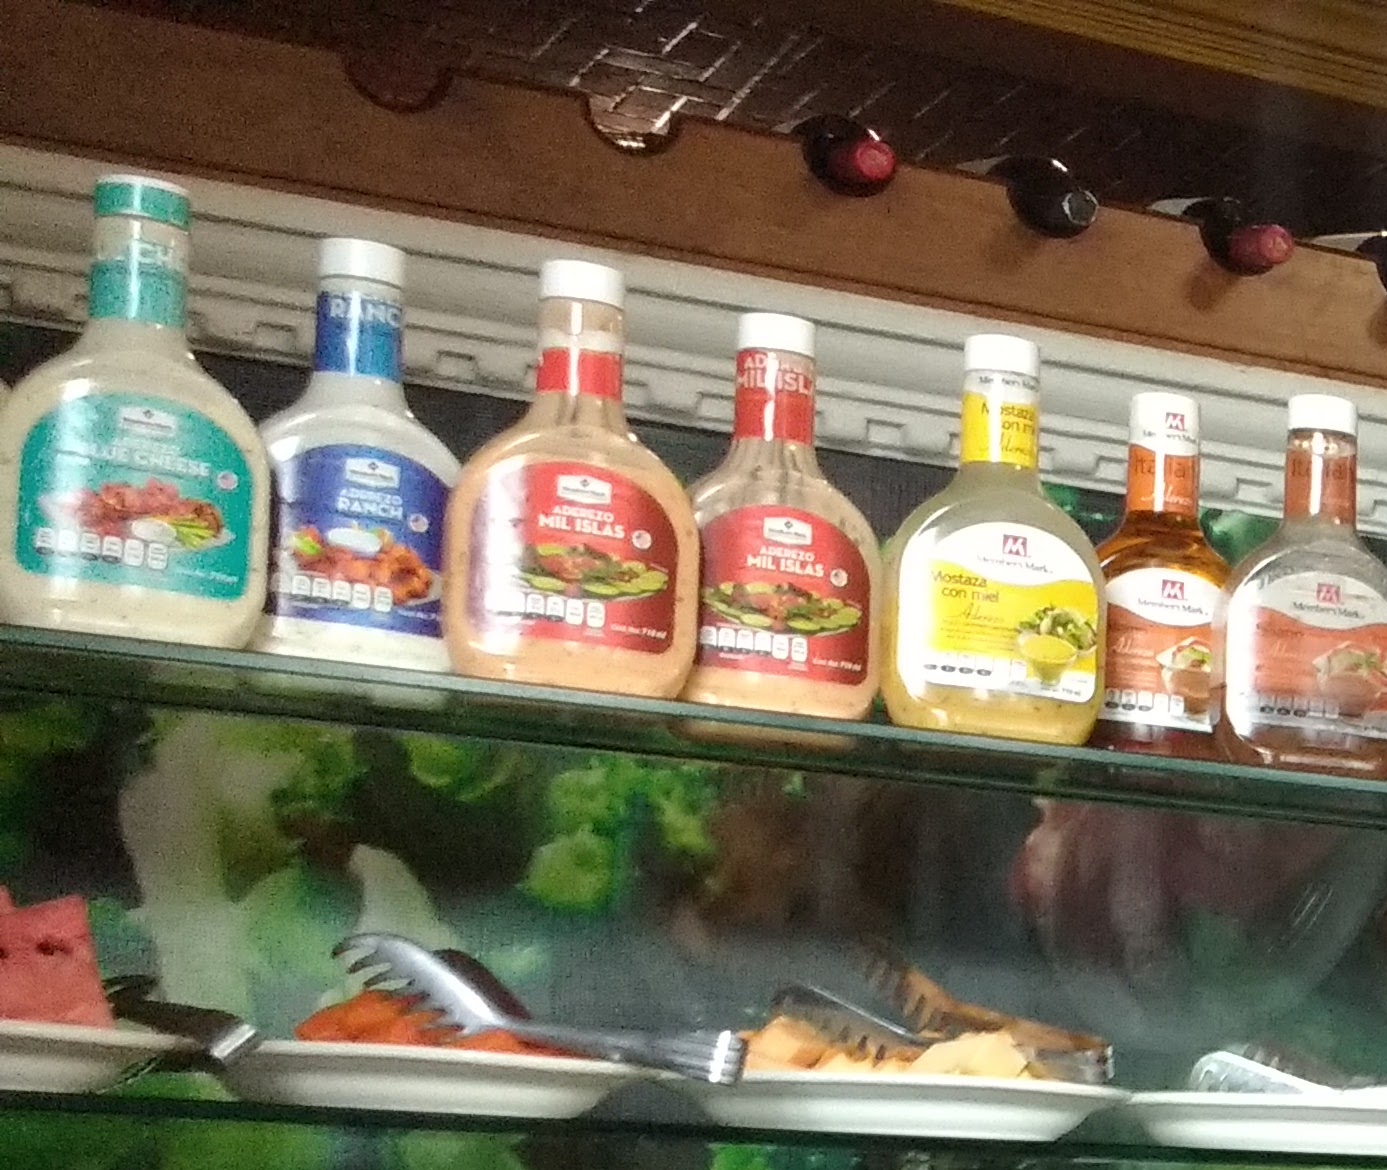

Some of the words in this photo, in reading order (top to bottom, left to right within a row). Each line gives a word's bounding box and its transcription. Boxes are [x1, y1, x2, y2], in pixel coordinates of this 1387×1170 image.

[337, 497, 403, 519] RANCH
[552, 505, 615, 524] ADEREZO
[538, 513, 571, 531] MIL
[575, 518, 625, 539] ISLAS
[759, 546, 815, 562] ADEREZO
[747, 555, 776, 571] MIL
[780, 558, 825, 578] ISLAS
[931, 570, 988, 588] Mostaza
[942, 586, 967, 599] con
[971, 589, 1000, 603] miel
